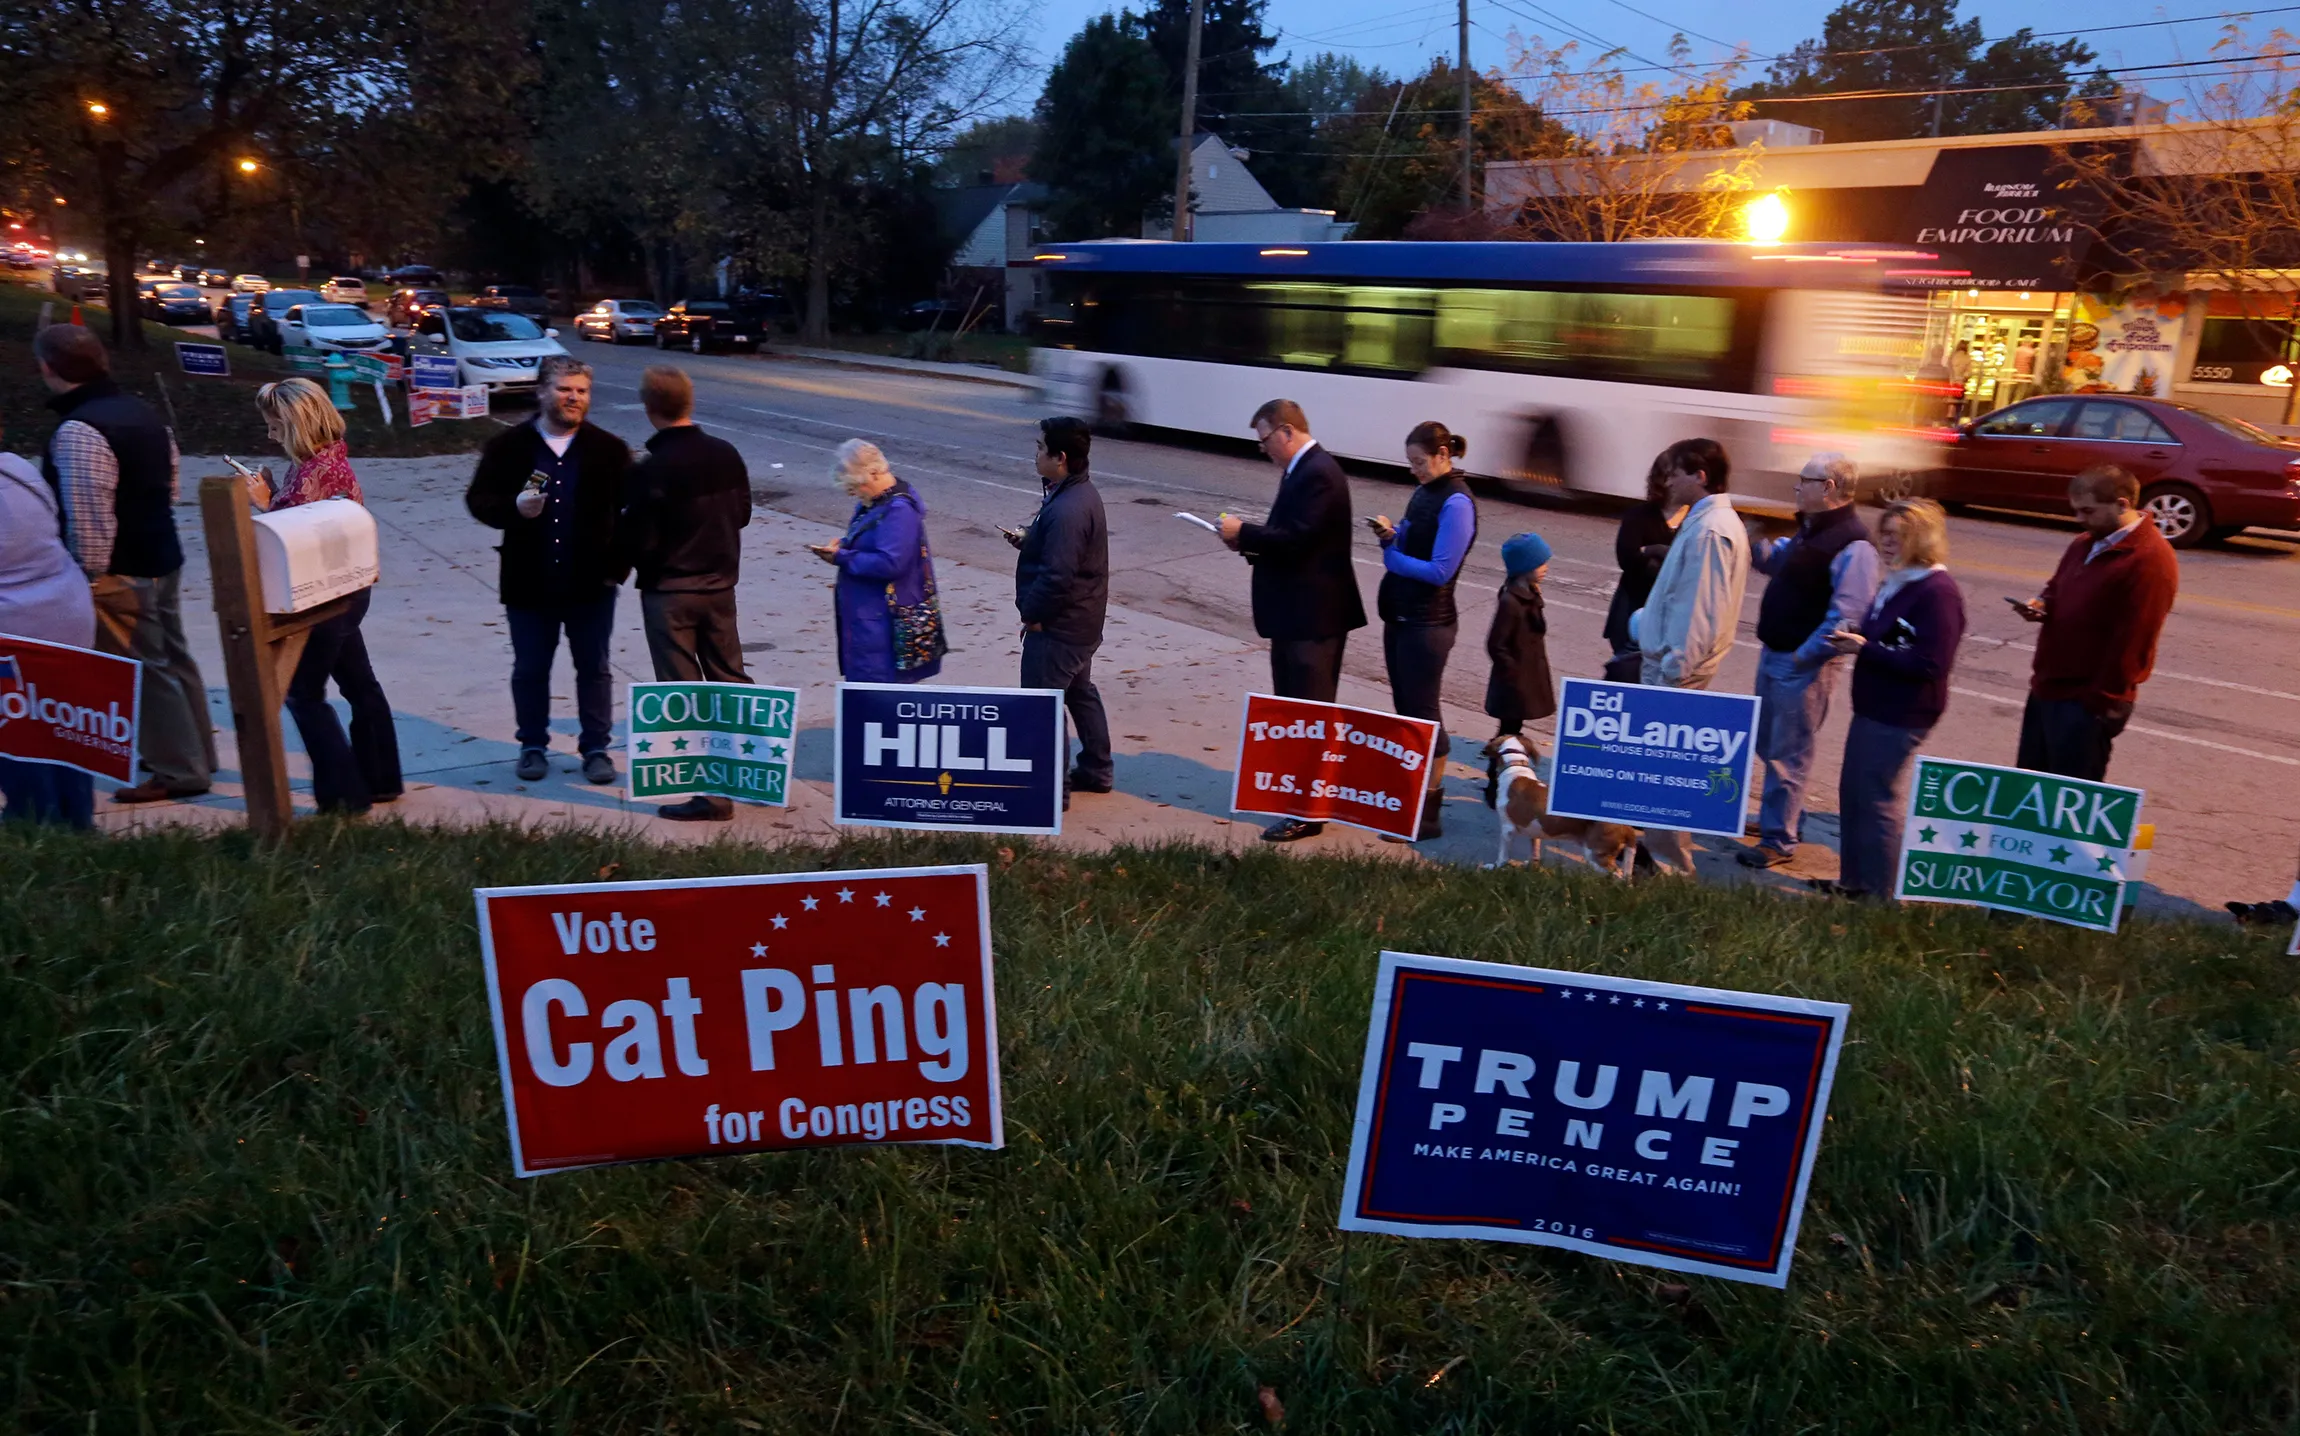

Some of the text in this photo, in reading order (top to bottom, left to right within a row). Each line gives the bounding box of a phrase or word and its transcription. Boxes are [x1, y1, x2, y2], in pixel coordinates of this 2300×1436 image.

[1916, 227, 2073, 244] EMPORIUM
[1957, 207, 2047, 225] FOOD
[2192, 366, 2232, 380] 5550
[0, 682, 133, 743] olcomb
[635, 691, 790, 730] COULTER
[896, 702, 999, 721] CURTIS
[1589, 690, 1624, 712] Ed
[701, 736, 732, 751] FOR
[863, 722, 1032, 772] HILL
[1249, 720, 1424, 771] Todd Young
[1564, 706, 1748, 765] DeLaney
[1601, 743, 1642, 756] HOUSE
[1645, 749, 1698, 763] DISTRICT
[1321, 751, 1347, 763] for
[1561, 763, 1614, 779] LEADING
[1616, 770, 1635, 781] ON
[1637, 772, 1661, 785] THE
[635, 761, 782, 794] TREASURER
[1254, 771, 1402, 811] U.S. Senate
[884, 797, 1008, 812] ATTORNEY GENERAL
[1943, 771, 2125, 841] CLARK
[1989, 834, 2034, 856] FOR
[1907, 860, 2106, 918] SURVEYOR
[551, 911, 657, 955] Vote
[521, 964, 970, 1087] Cat Ping
[1406, 1041, 1791, 1128] TRUMP
[704, 1095, 972, 1144] for Congress
[1428, 1102, 1741, 1169] PENCE
[1413, 1143, 1741, 1197] MAKE AMERICA GREAT AGAIN!
[1533, 1217, 1595, 1240] 2016
